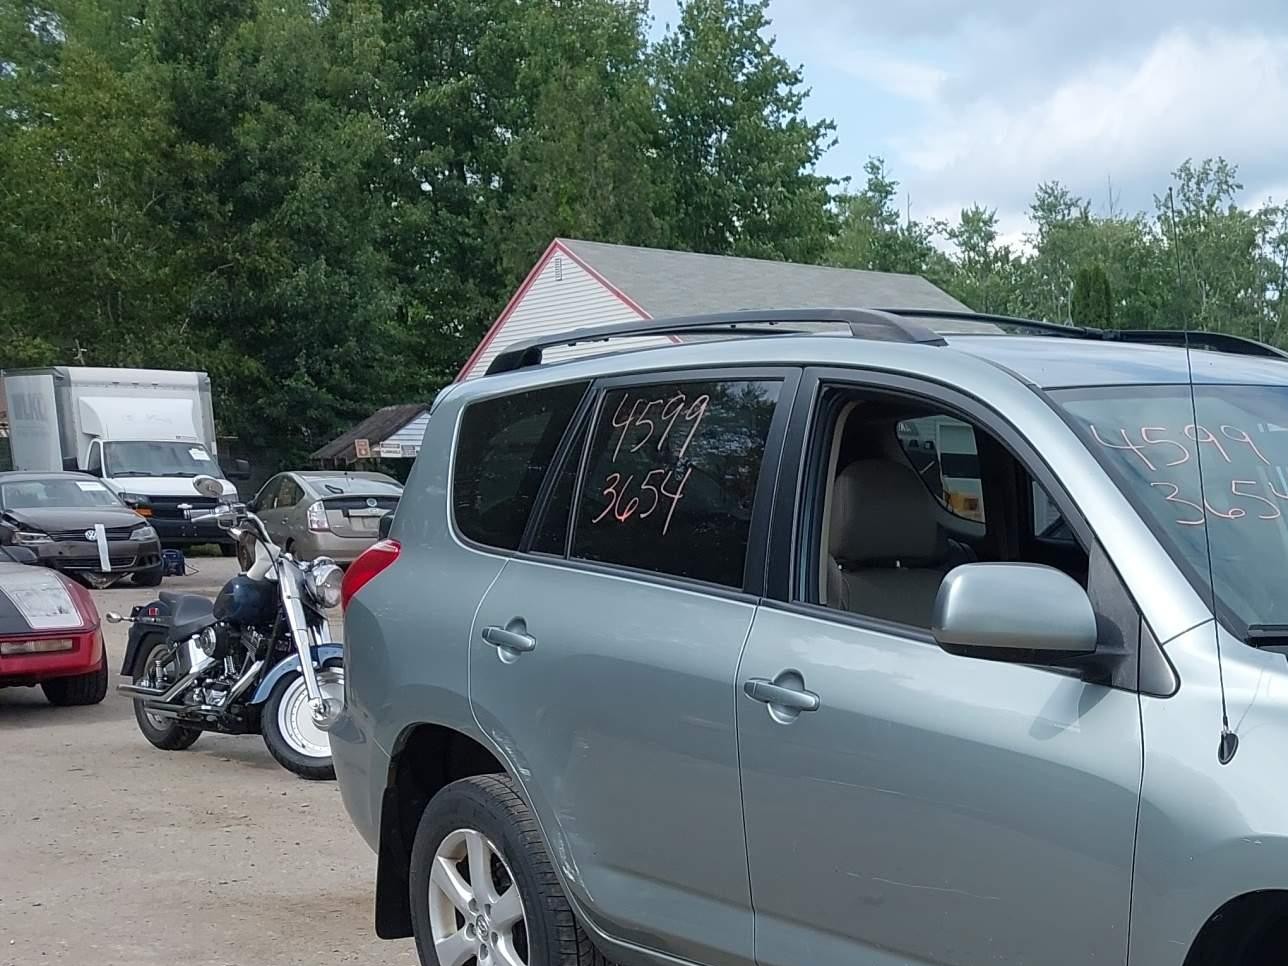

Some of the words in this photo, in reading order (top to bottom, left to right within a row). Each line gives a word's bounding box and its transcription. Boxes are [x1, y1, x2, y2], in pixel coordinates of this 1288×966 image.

[612, 391, 710, 463] 4599
[1089, 424, 1271, 471] 4599
[591, 467, 693, 537] 3654
